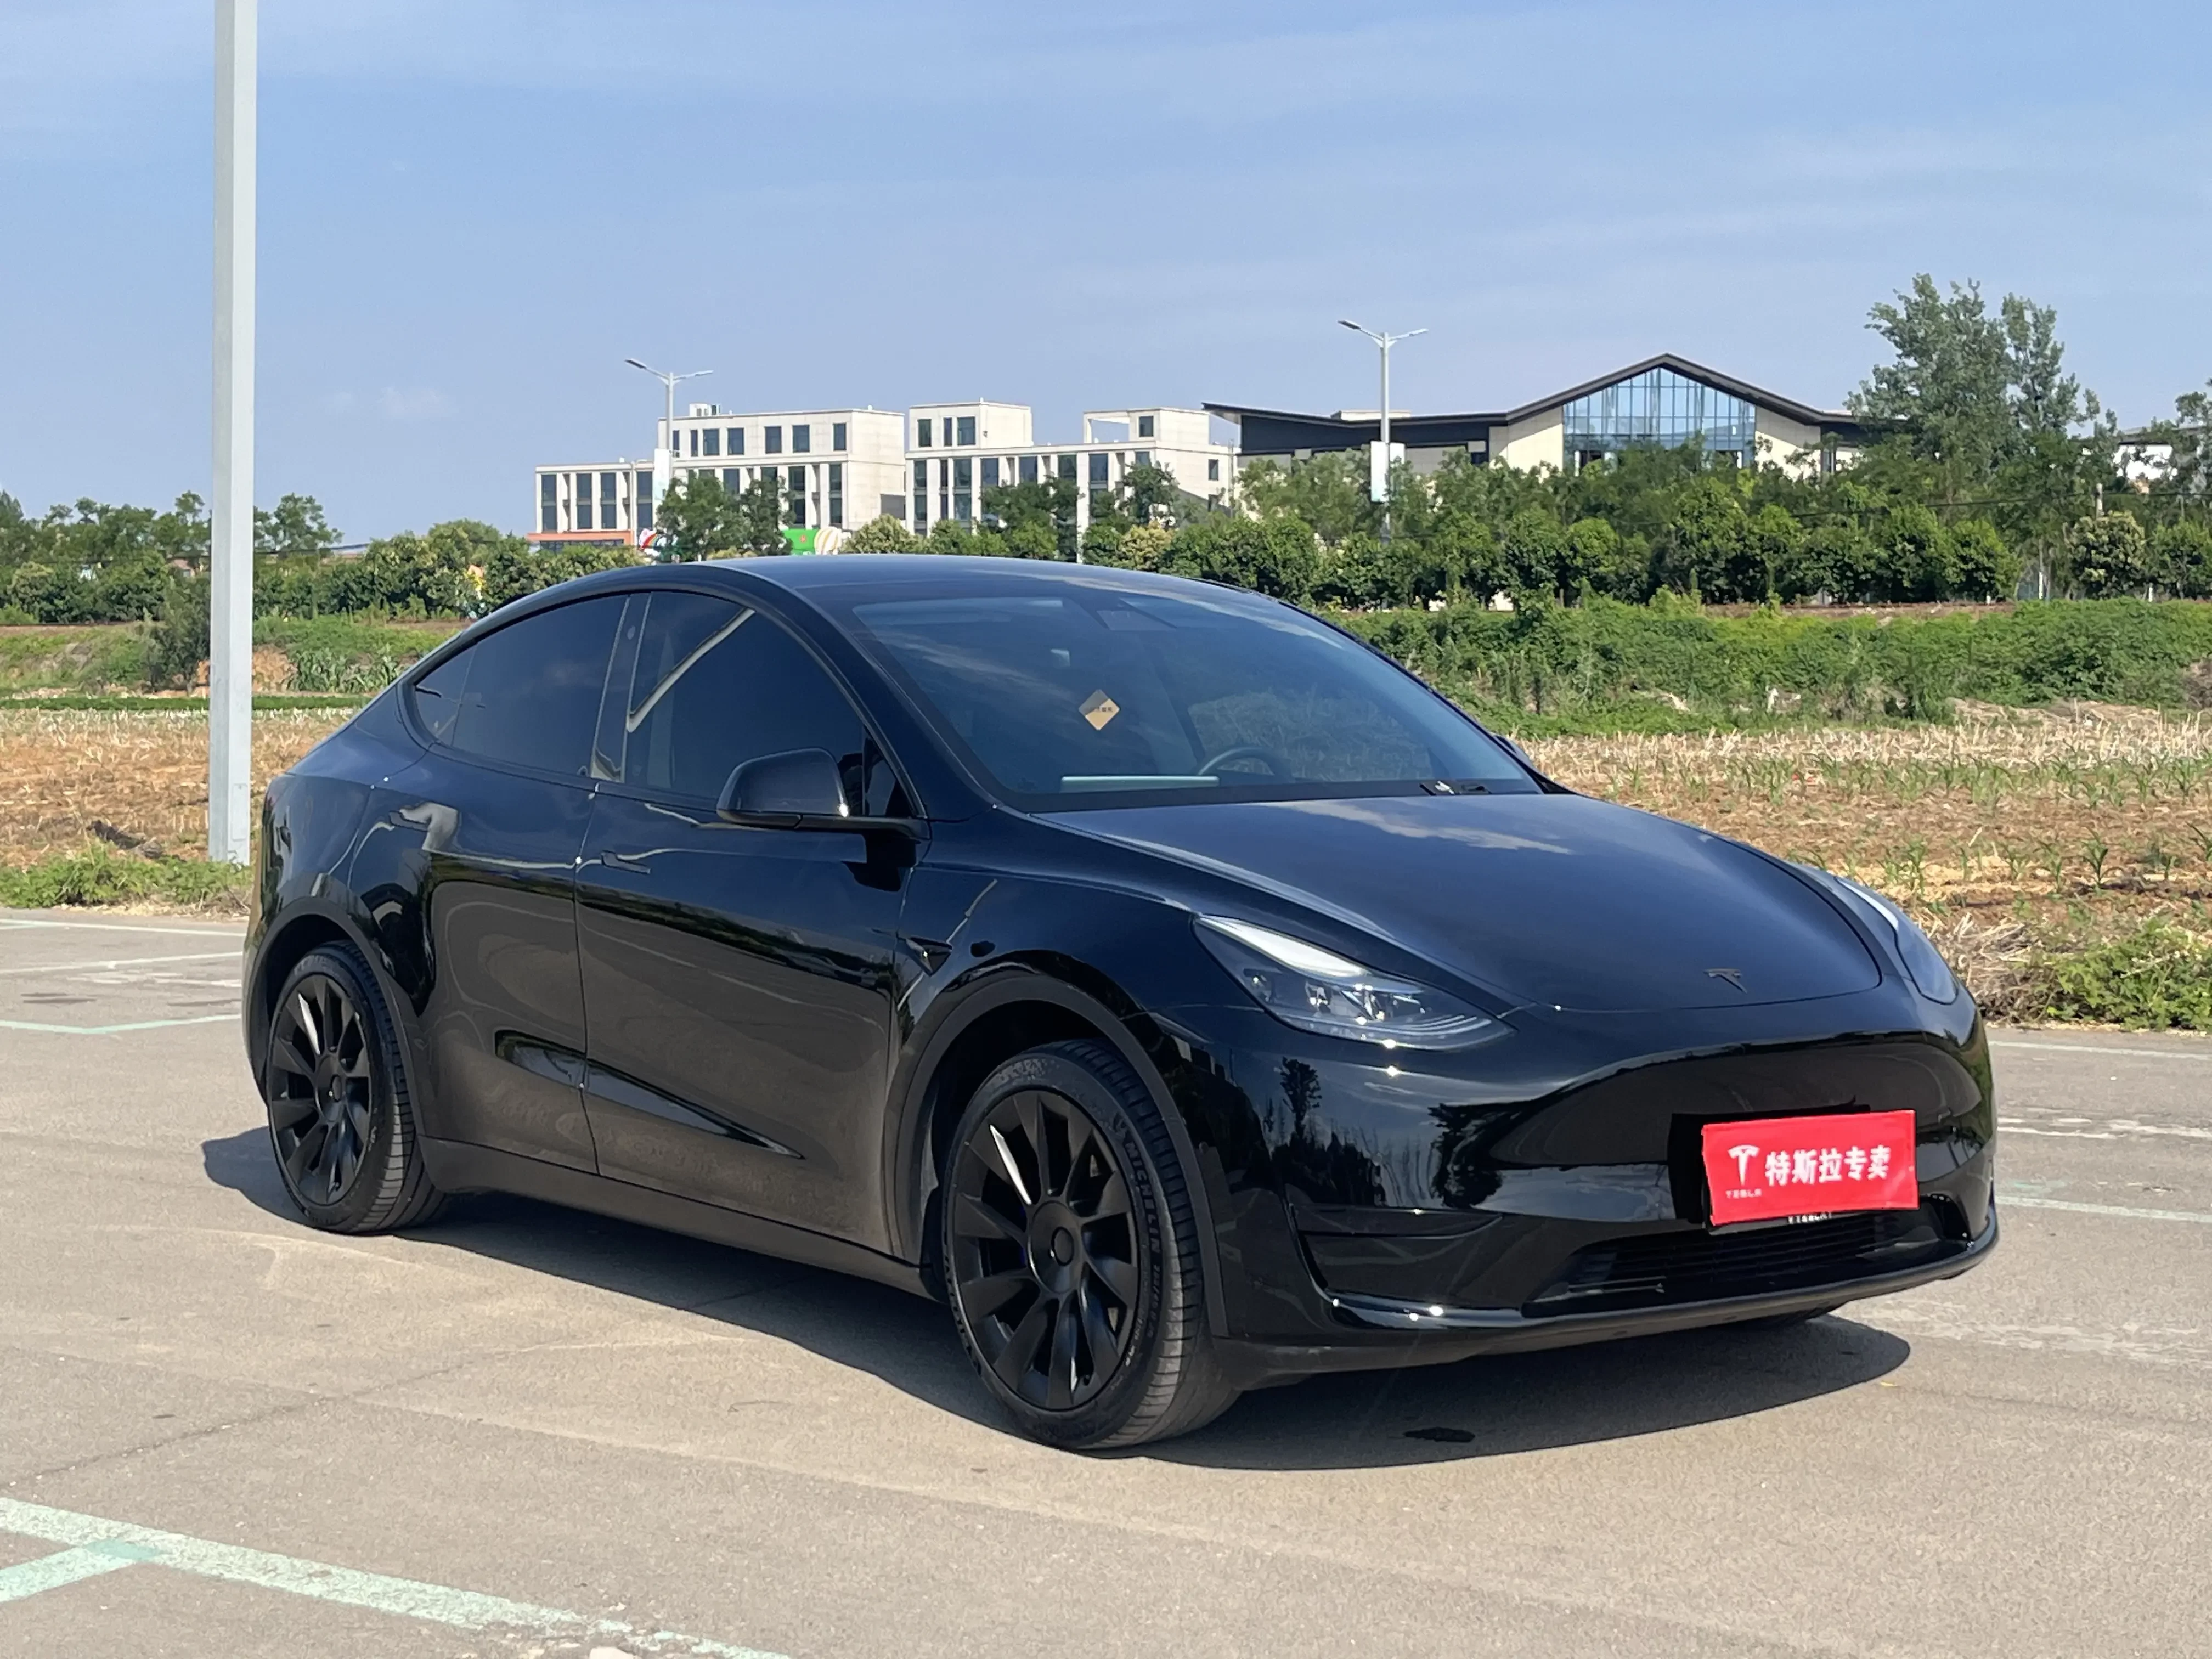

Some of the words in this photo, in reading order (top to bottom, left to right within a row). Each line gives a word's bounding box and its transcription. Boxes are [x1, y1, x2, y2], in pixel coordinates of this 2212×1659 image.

[1764, 1144, 1891, 1187] 特斯拉专卖
